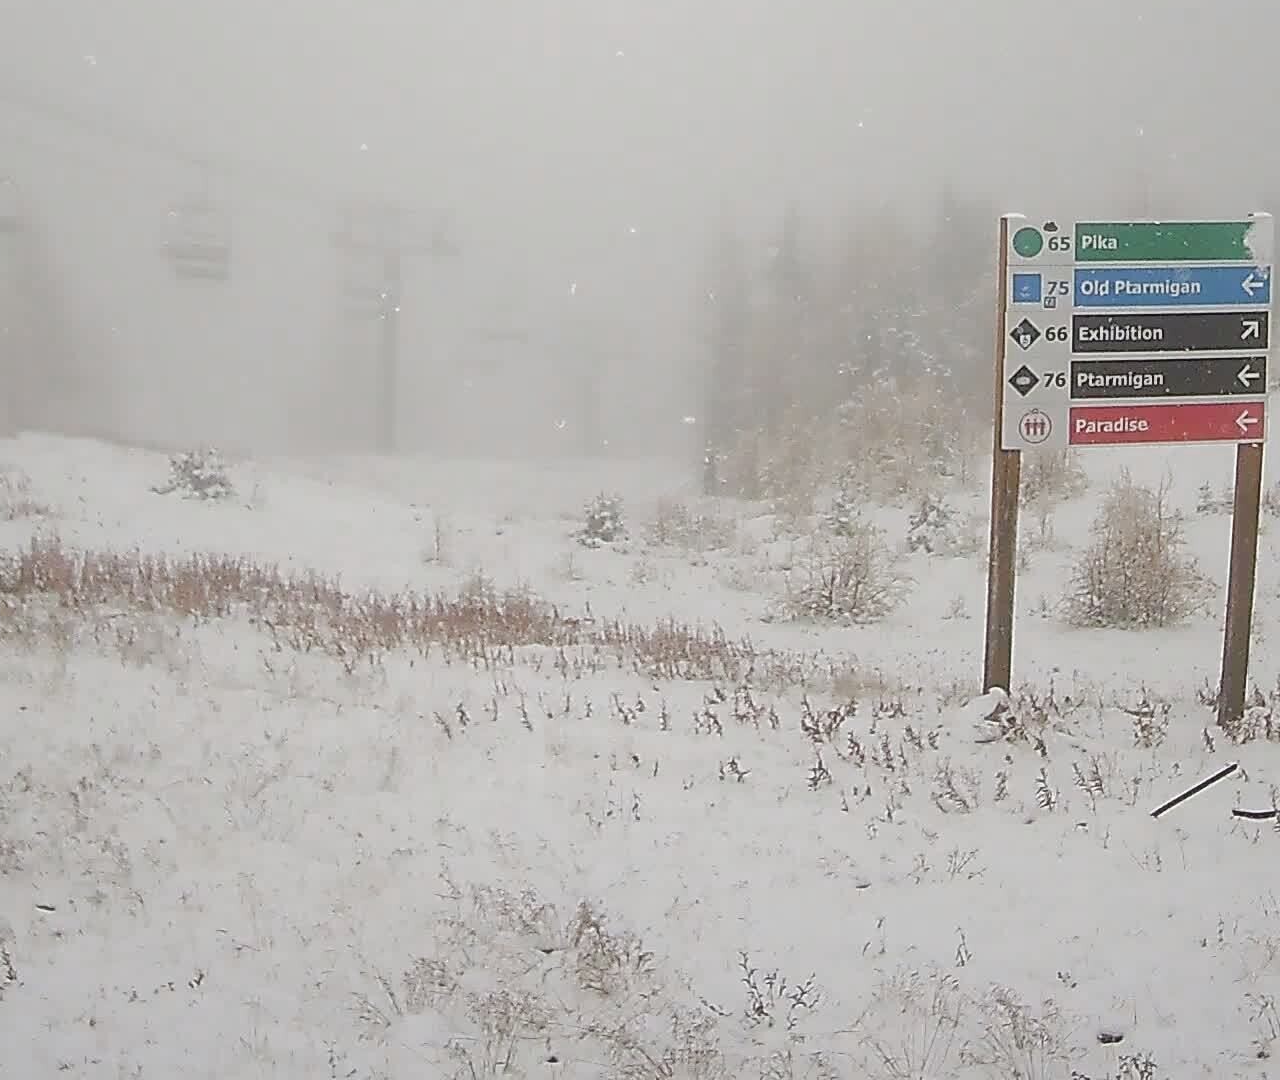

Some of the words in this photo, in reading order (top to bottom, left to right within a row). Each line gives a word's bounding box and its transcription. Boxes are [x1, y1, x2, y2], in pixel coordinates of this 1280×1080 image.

[1048, 236, 1070, 251] 65
[1081, 235, 1118, 250] Pika
[1047, 281, 1069, 296] 75
[1080, 280, 1109, 296] Old
[1115, 278, 1201, 296] Ptarmigan
[1045, 326, 1068, 342] 66
[1079, 325, 1163, 341] Exhibition
[1044, 373, 1066, 388] 76
[1077, 372, 1164, 390] Ptarmigan
[1075, 417, 1148, 433] Paradise
